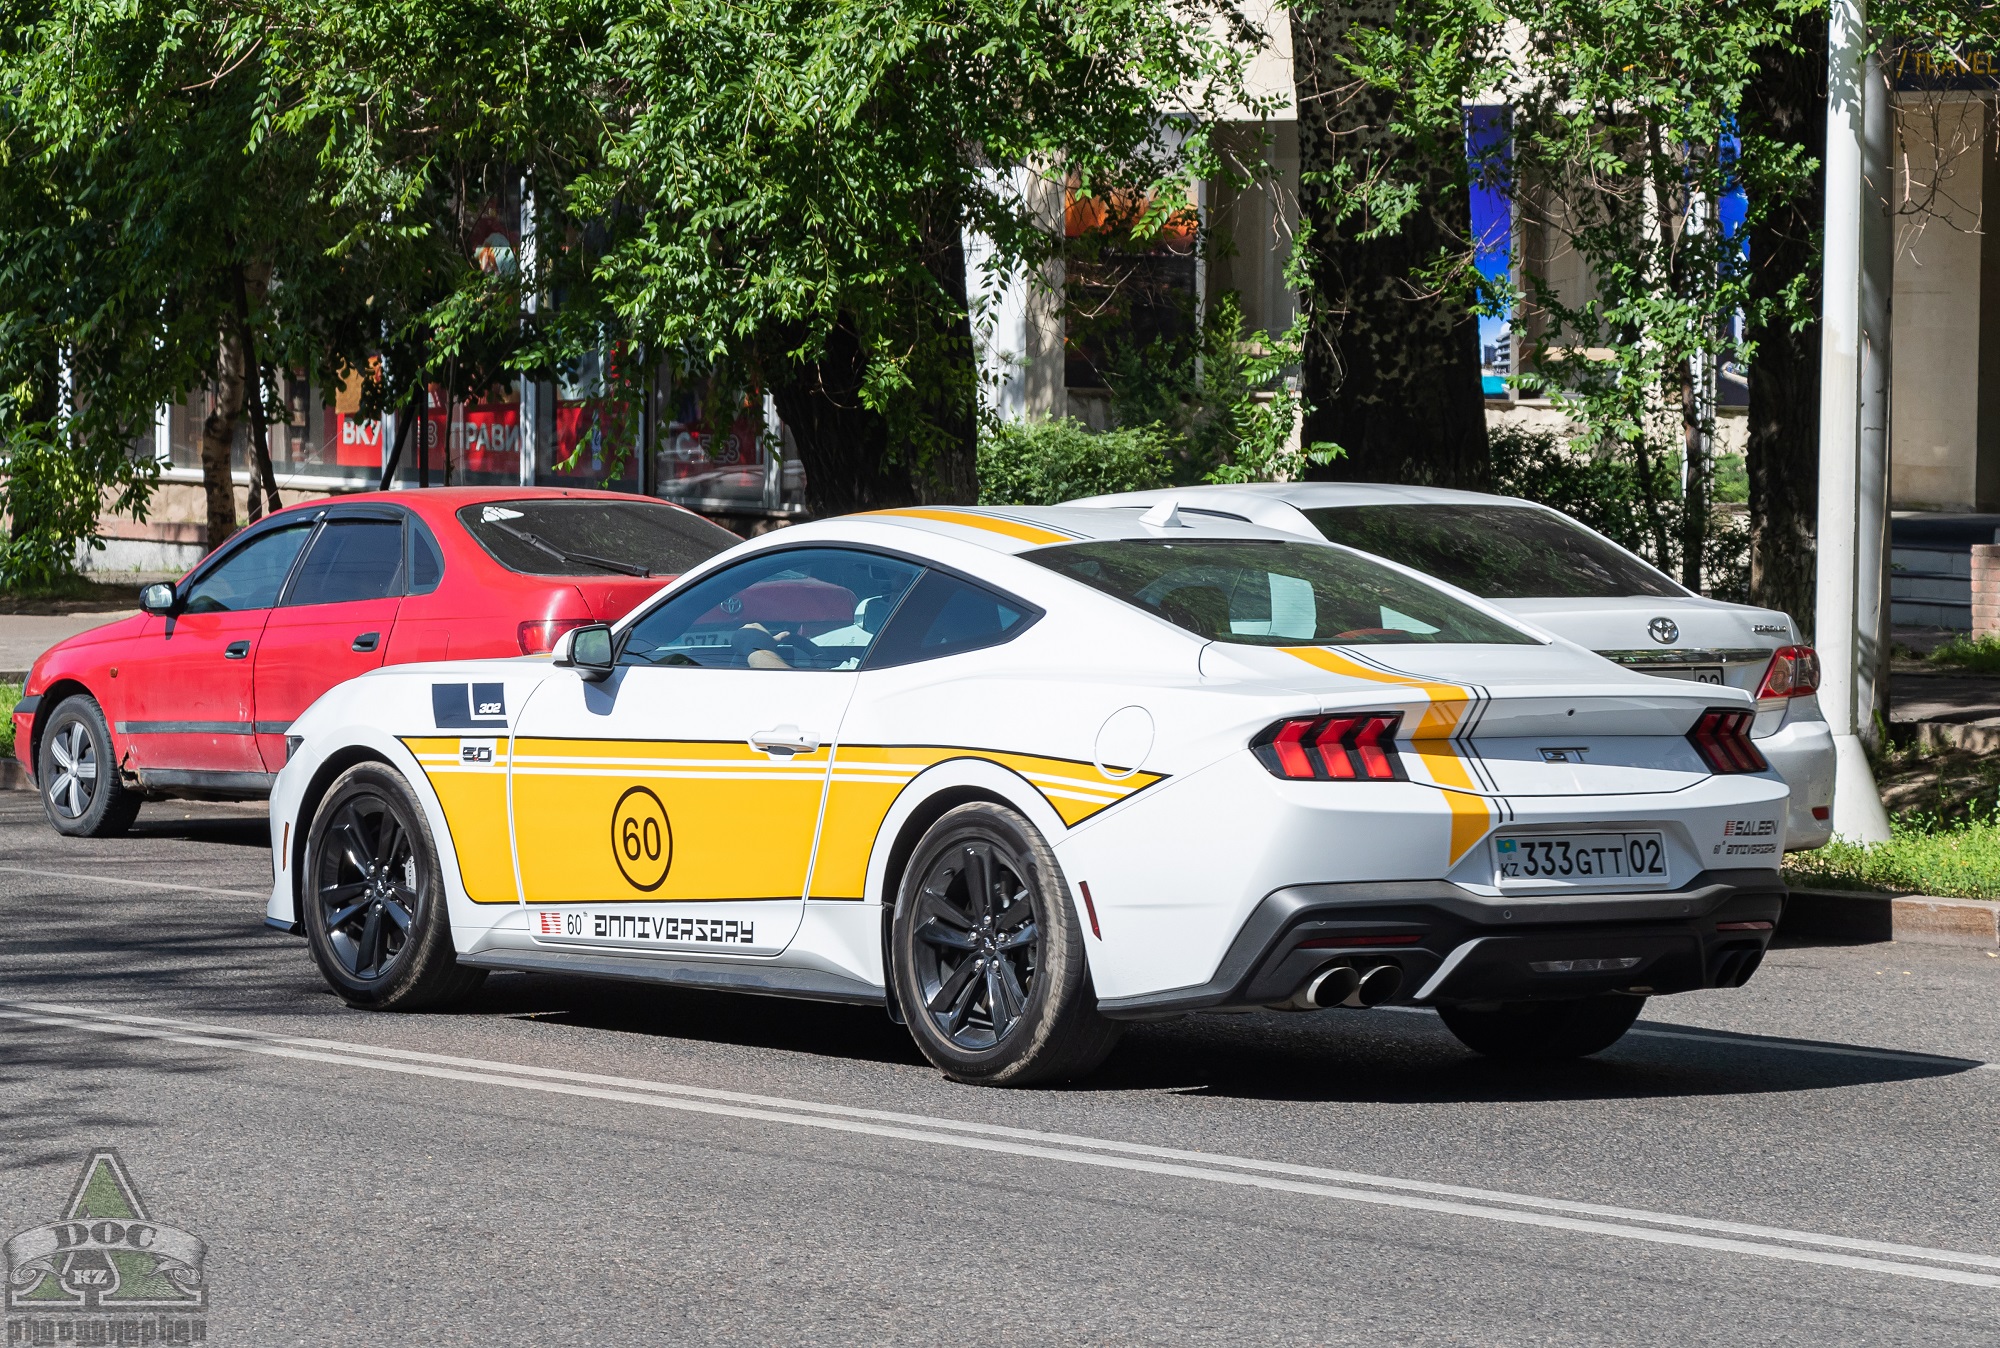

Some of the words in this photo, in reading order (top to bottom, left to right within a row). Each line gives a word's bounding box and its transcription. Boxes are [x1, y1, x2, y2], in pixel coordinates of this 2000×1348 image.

[479, 703, 501, 714] 302
[1536, 746, 1590, 764] GT
[1734, 820, 1779, 836] SALEEN
[623, 817, 661, 861] 60
[1629, 839, 1663, 874] 02
[1501, 863, 1520, 877] KZ
